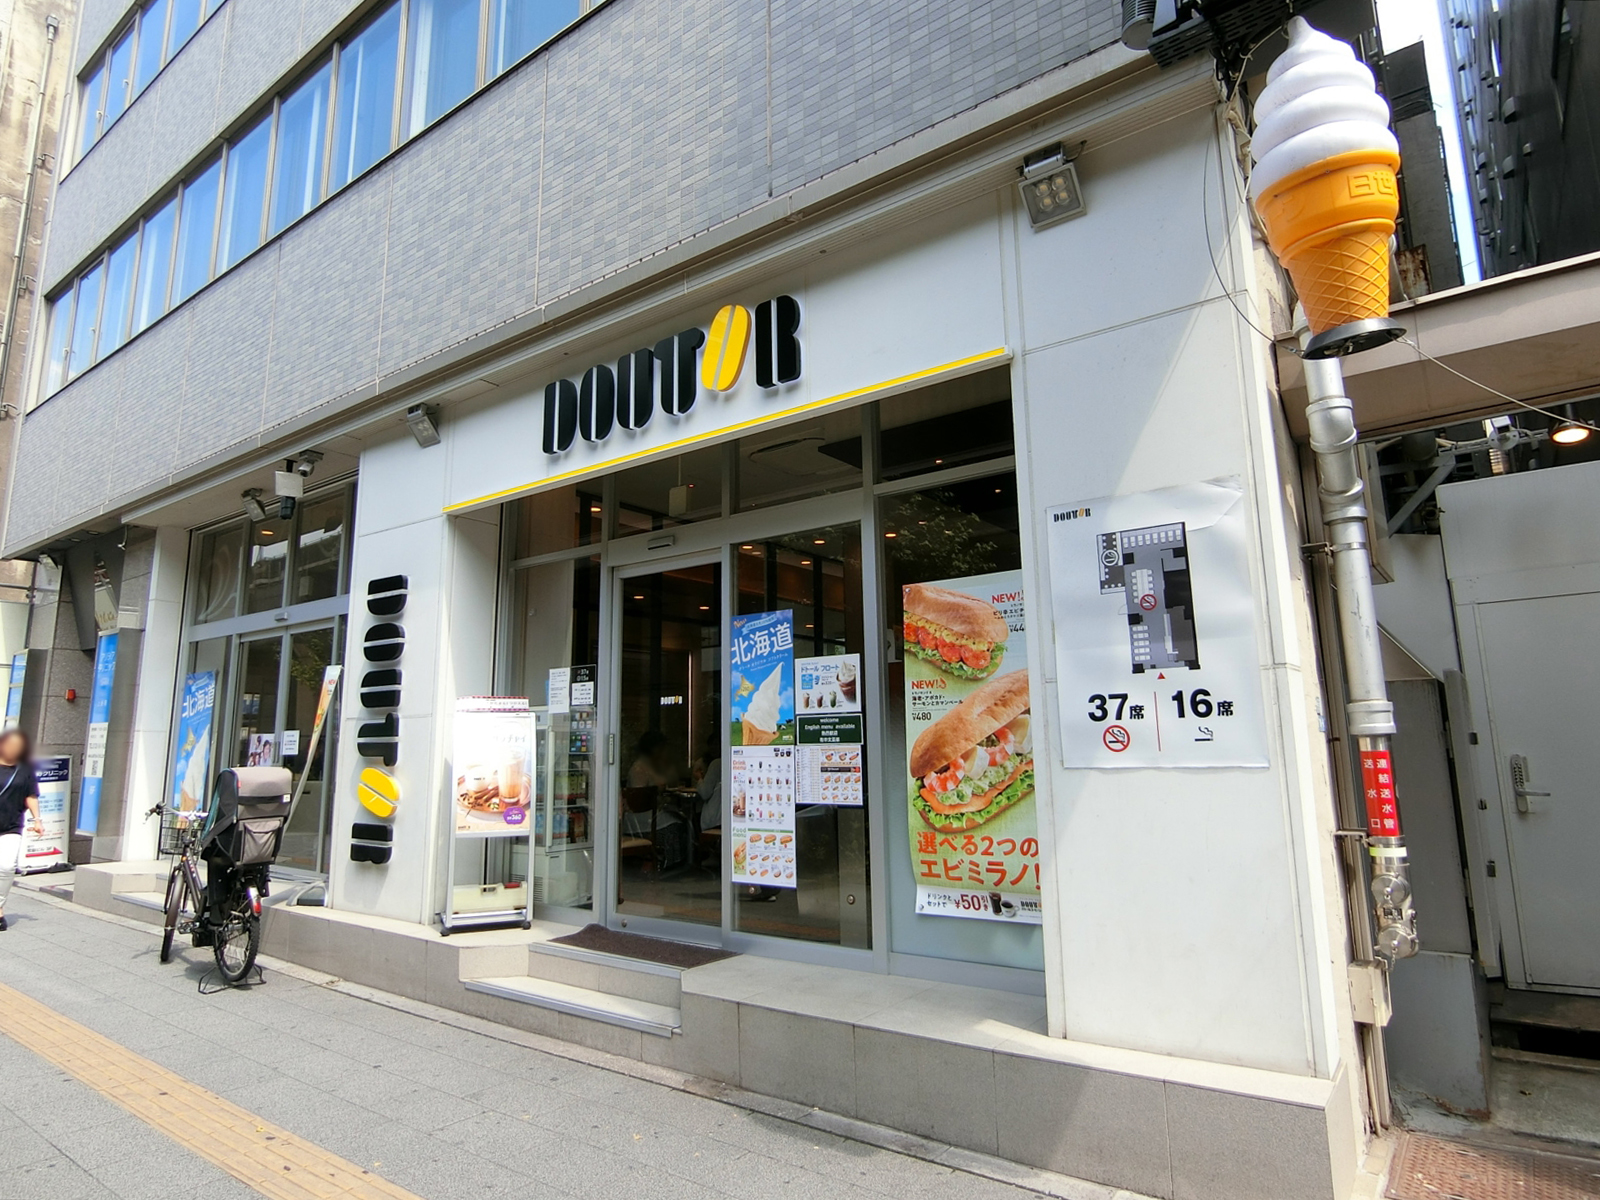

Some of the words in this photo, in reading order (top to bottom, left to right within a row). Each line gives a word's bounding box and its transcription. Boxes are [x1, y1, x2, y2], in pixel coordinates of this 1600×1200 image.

[542, 294, 803, 456] DOUTOR
[1053, 507, 1091, 523] DOUTOR
[732, 622, 793, 664] 北海道
[182, 684, 215, 718] 北海道
[911, 679, 939, 690] NEW!
[350, 574, 408, 865] DOUTOR
[1088, 693, 1144, 721] 37席
[1171, 689, 1234, 718] 16席
[1364, 759, 1381, 828] 送水口
[1377, 759, 1395, 829] 連結送水管
[917, 832, 1039, 858] 選べる2つの
